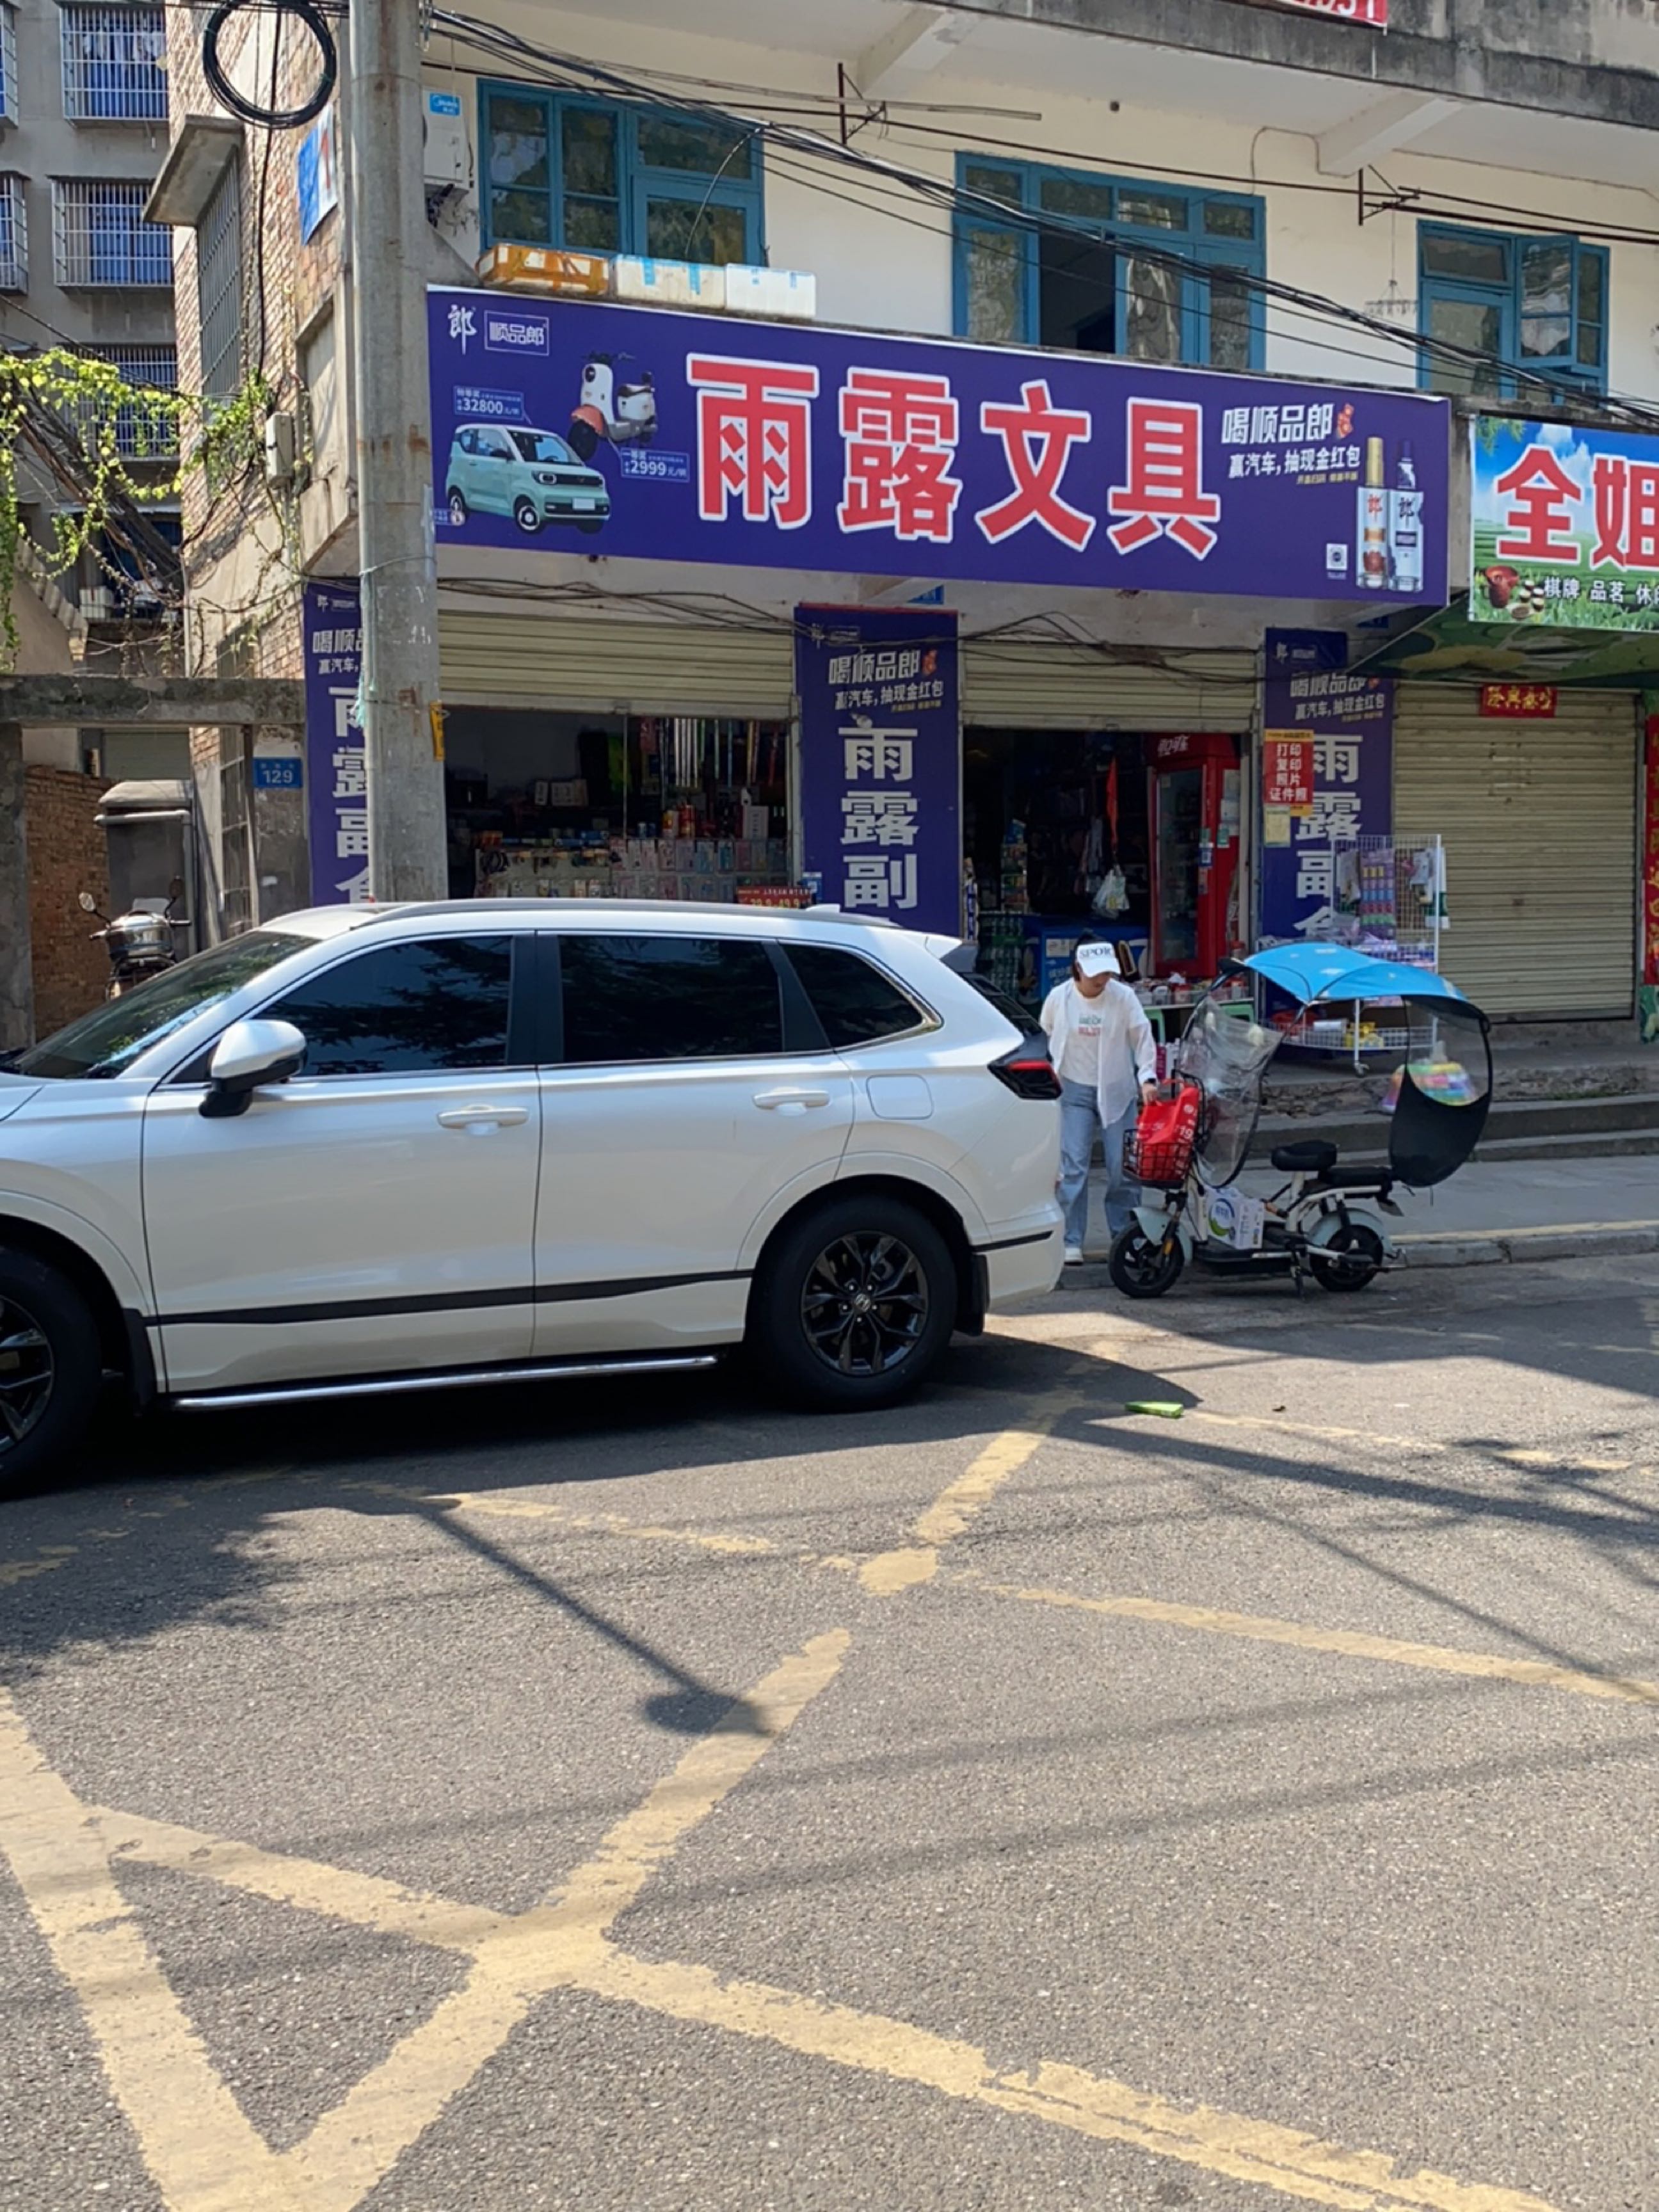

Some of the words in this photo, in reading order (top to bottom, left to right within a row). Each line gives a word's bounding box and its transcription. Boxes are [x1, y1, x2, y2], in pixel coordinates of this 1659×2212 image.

[448, 305, 477, 355] 郎
[488, 321, 545, 346] 顺品郎
[1221, 403, 1334, 444] 喝顺品郎
[687, 353, 1220, 561] 雨露文具
[1543, 575, 1581, 600] 棋牌
[1591, 580, 1626, 604] 品茗
[828, 649, 920, 684] 喝顺品郎
[1277, 743, 1301, 757] 打印
[262, 769, 293, 784] 129
